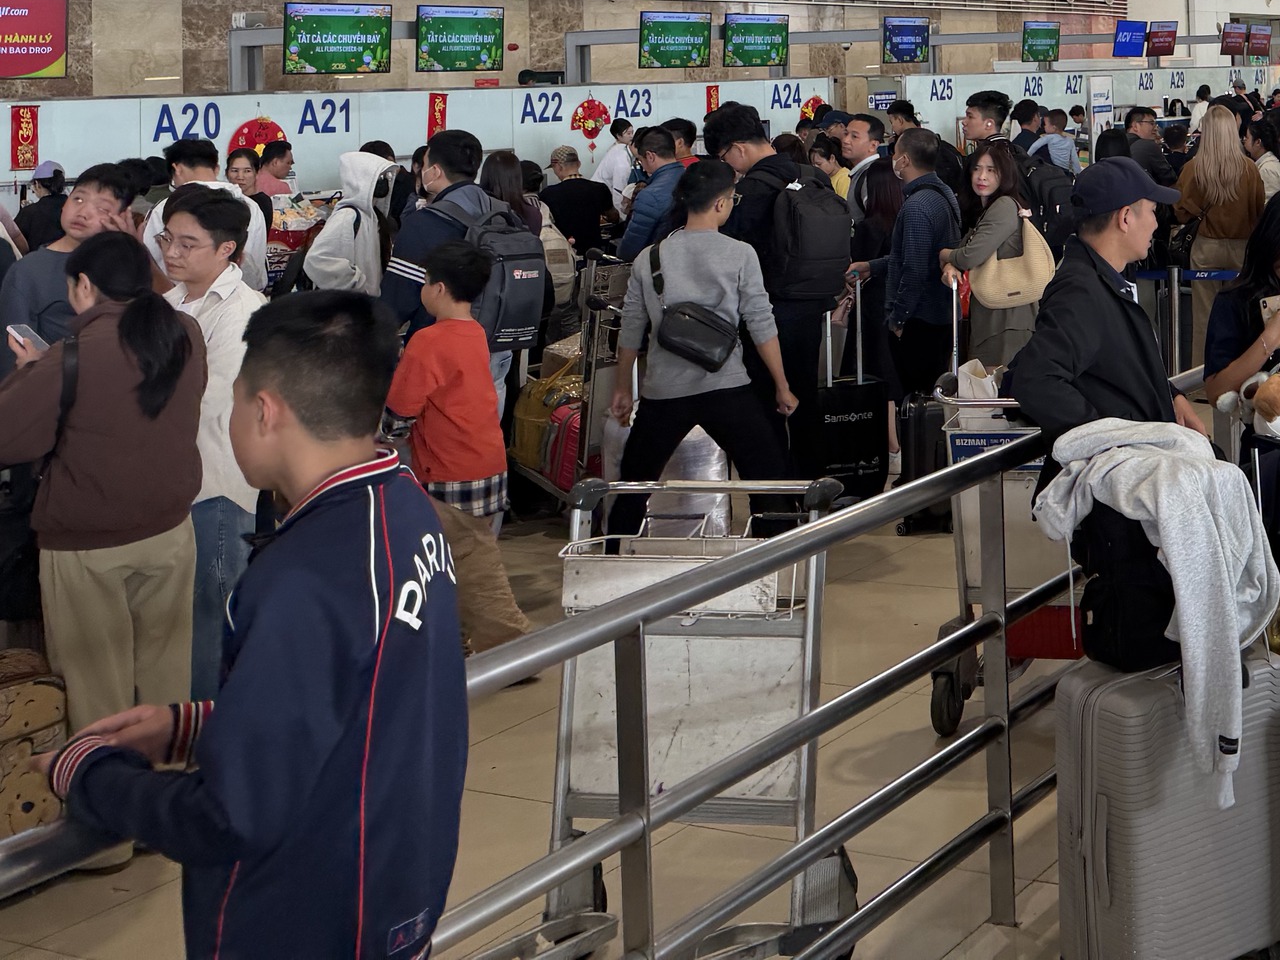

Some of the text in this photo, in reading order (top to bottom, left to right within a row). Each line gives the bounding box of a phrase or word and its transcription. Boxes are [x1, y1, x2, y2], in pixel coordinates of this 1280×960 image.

[5, 32, 37, 44] HÀNH
[39, 32, 53, 44] LÝ
[322, 31, 337, 43] CÁC
[366, 31, 380, 43] BAY
[449, 32, 460, 43] CÁC
[481, 32, 495, 43] BAY
[1116, 31, 1132, 43] ACV
[9, 46, 28, 54] BAG
[29, 46, 53, 54] DROP
[1065, 74, 1083, 94] A27
[1138, 72, 1154, 90] A28
[1170, 71, 1185, 89] A29
[1228, 69, 1242, 87] A30
[1254, 69, 1266, 85] A31
[930, 78, 953, 101] A25
[1023, 76, 1043, 97] A26
[614, 88, 652, 118] A23
[770, 83, 802, 110] A24
[297, 98, 350, 135] A21
[520, 92, 563, 124] A22
[153, 102, 221, 142] A20
[955, 438, 987, 446] BIZMAN
